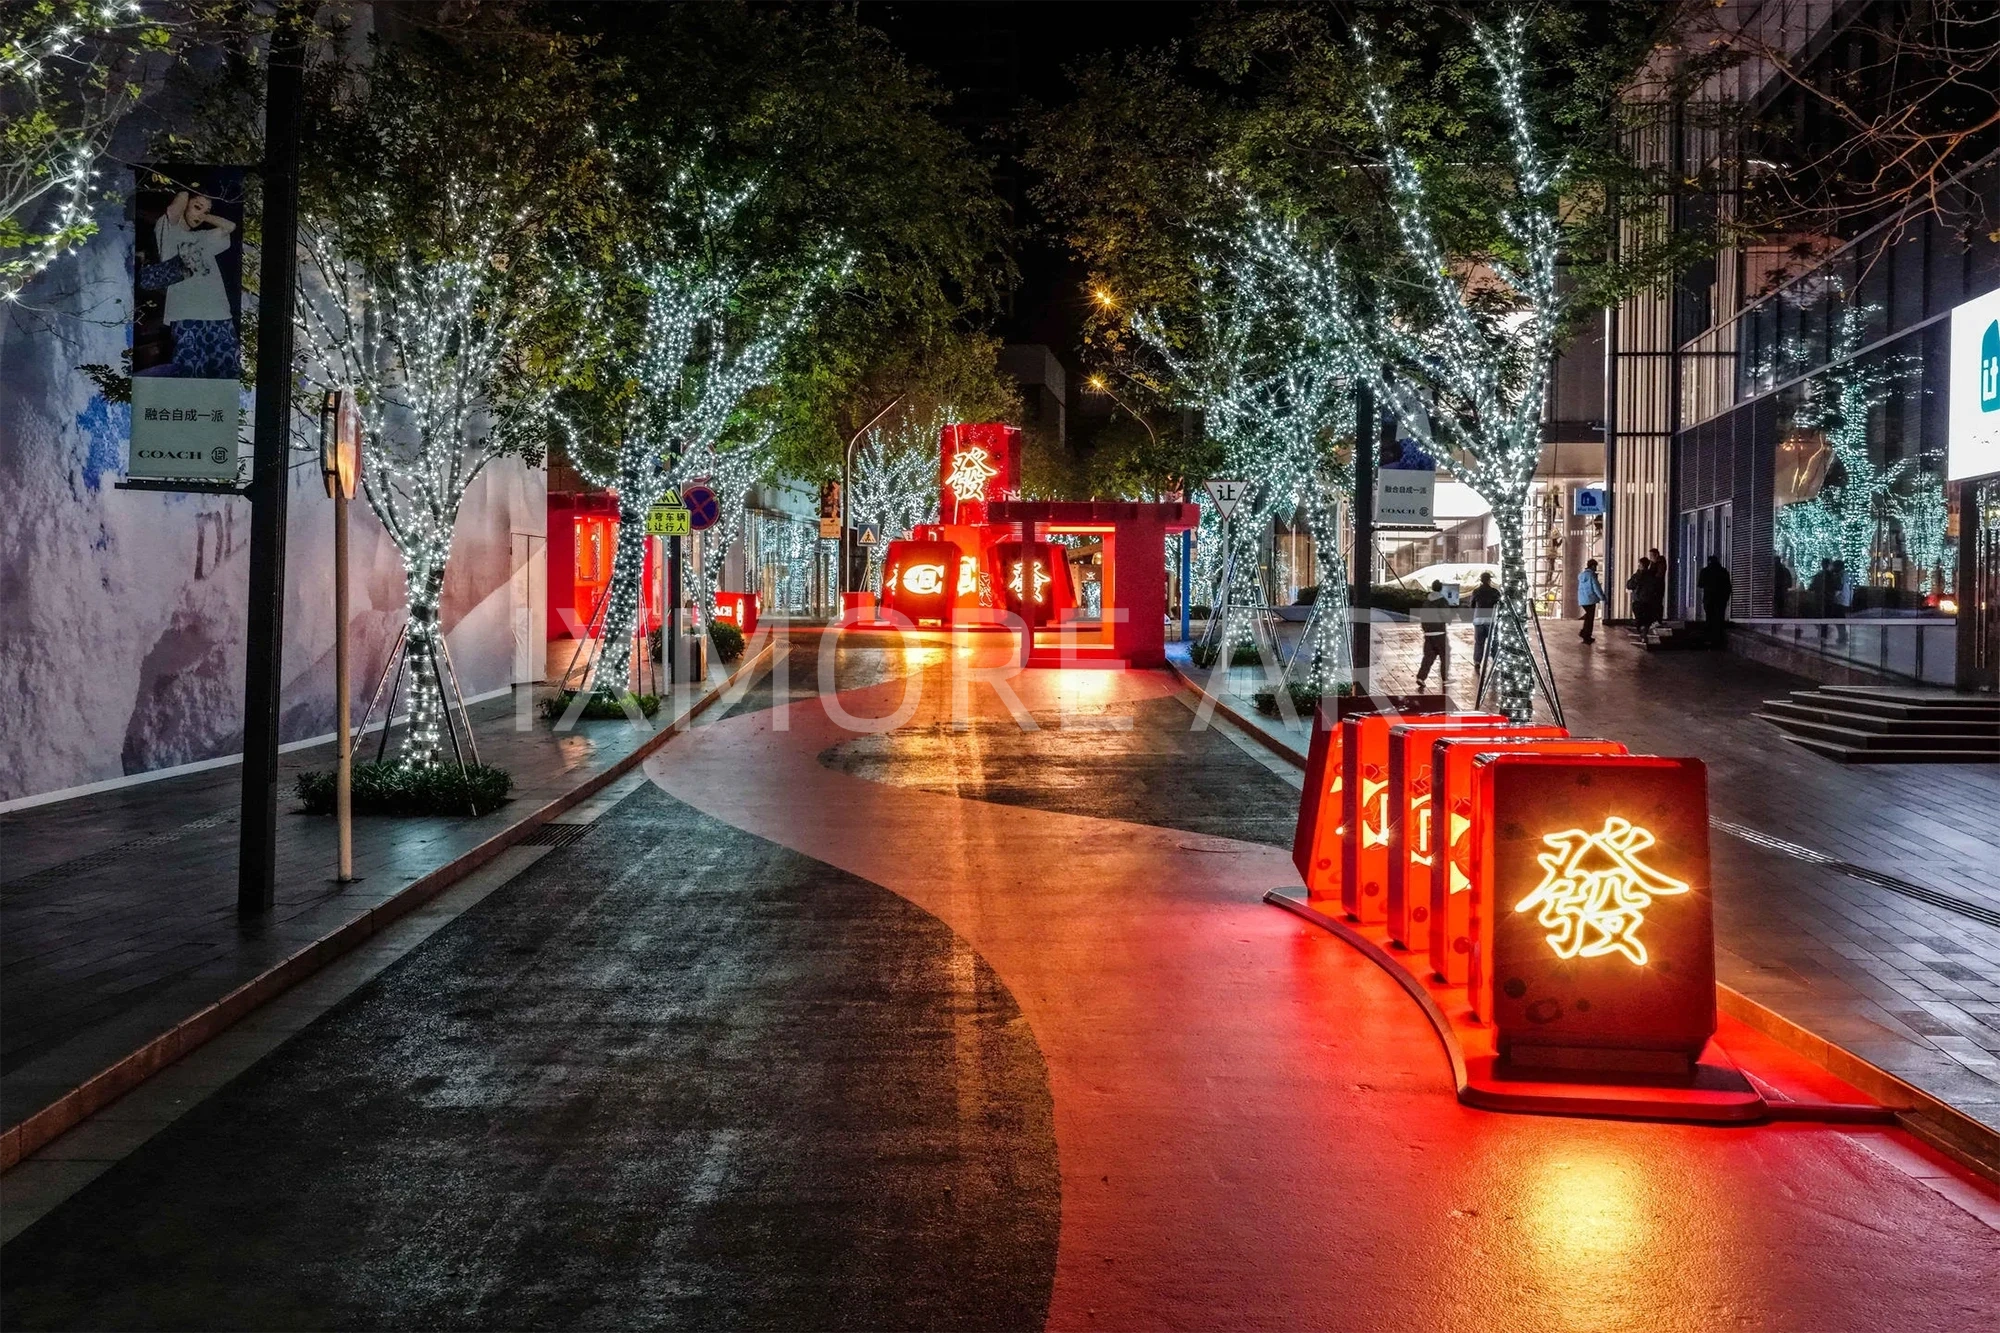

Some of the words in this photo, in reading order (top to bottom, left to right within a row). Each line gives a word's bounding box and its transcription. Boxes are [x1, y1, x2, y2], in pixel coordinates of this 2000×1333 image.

[144, 407, 224, 422] 融合自成一派
[138, 450, 202, 460] COACH
[945, 446, 998, 501] 發
[1217, 484, 1236, 501] 让
[1514, 815, 1690, 966] 發
